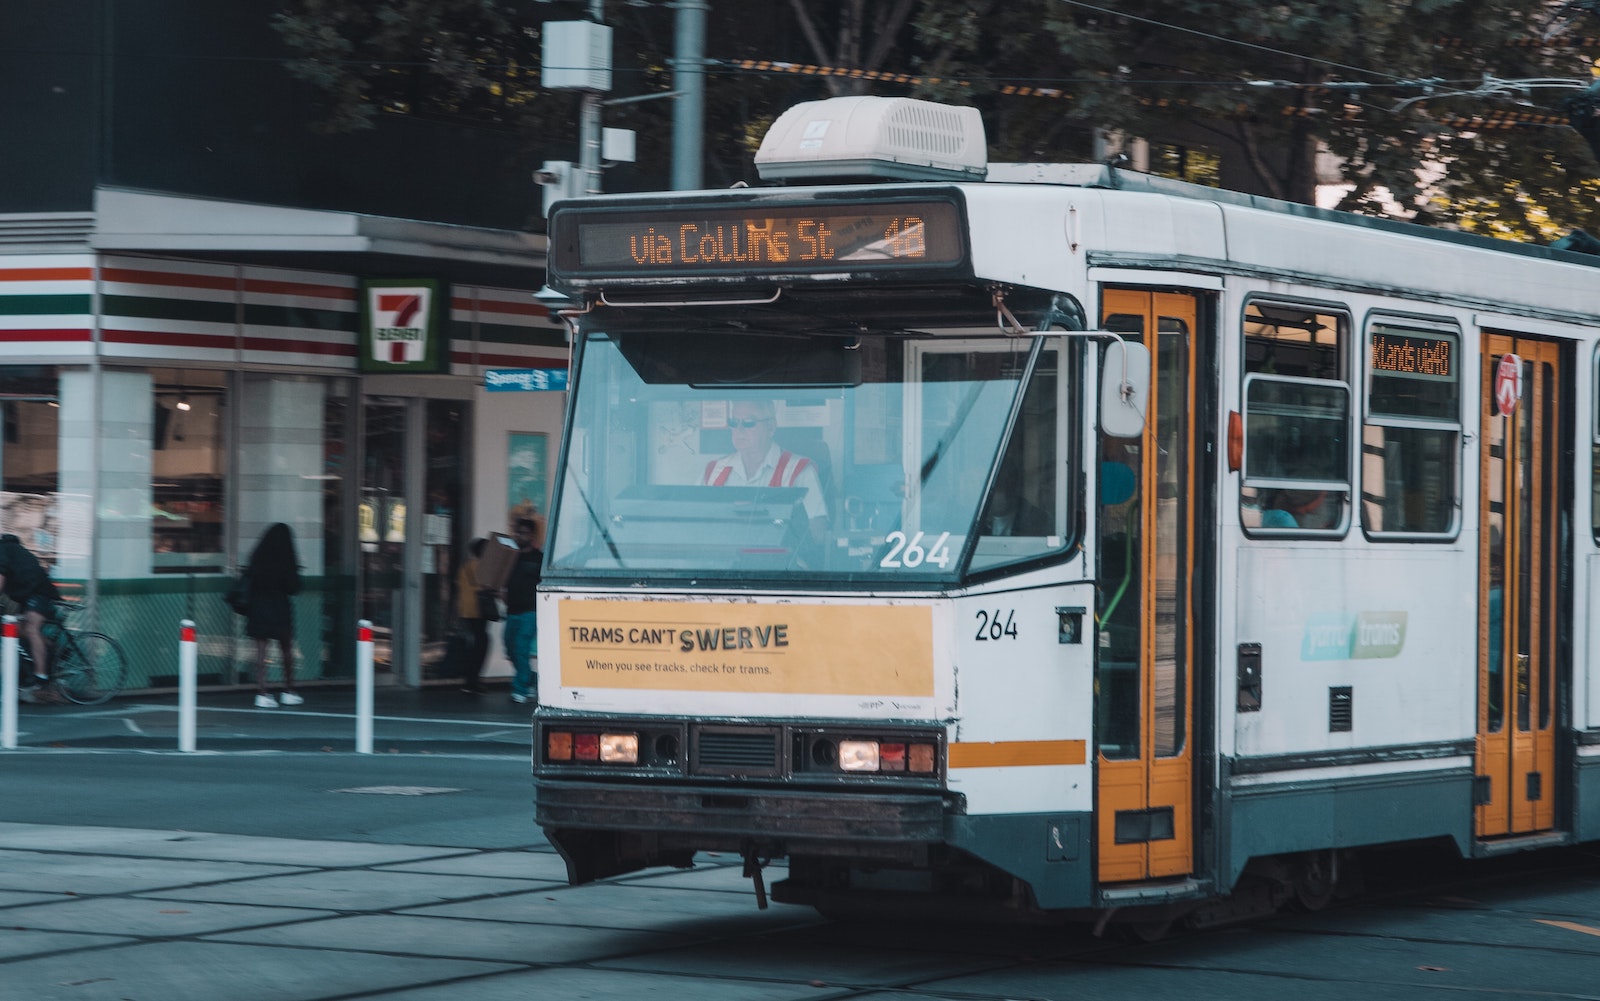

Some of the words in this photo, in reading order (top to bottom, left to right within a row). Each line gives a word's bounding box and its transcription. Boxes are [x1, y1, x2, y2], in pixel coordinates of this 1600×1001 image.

[630, 227, 672, 264] via
[680, 223, 789, 263] Collins
[798, 219, 835, 260] St
[884, 216, 924, 258] 48
[377, 295, 422, 362] 7
[880, 531, 950, 568] 264
[569, 626, 624, 643] TRAMS
[628, 628, 677, 645] CAN'T
[679, 624, 789, 652] SWERVE
[975, 609, 1018, 641] 264
[1360, 619, 1400, 647] trams
[585, 659, 613, 671] When
[615, 662, 632, 673] you
[634, 663, 652, 672] see
[690, 662, 719, 674] check
[722, 662, 736, 674] for
